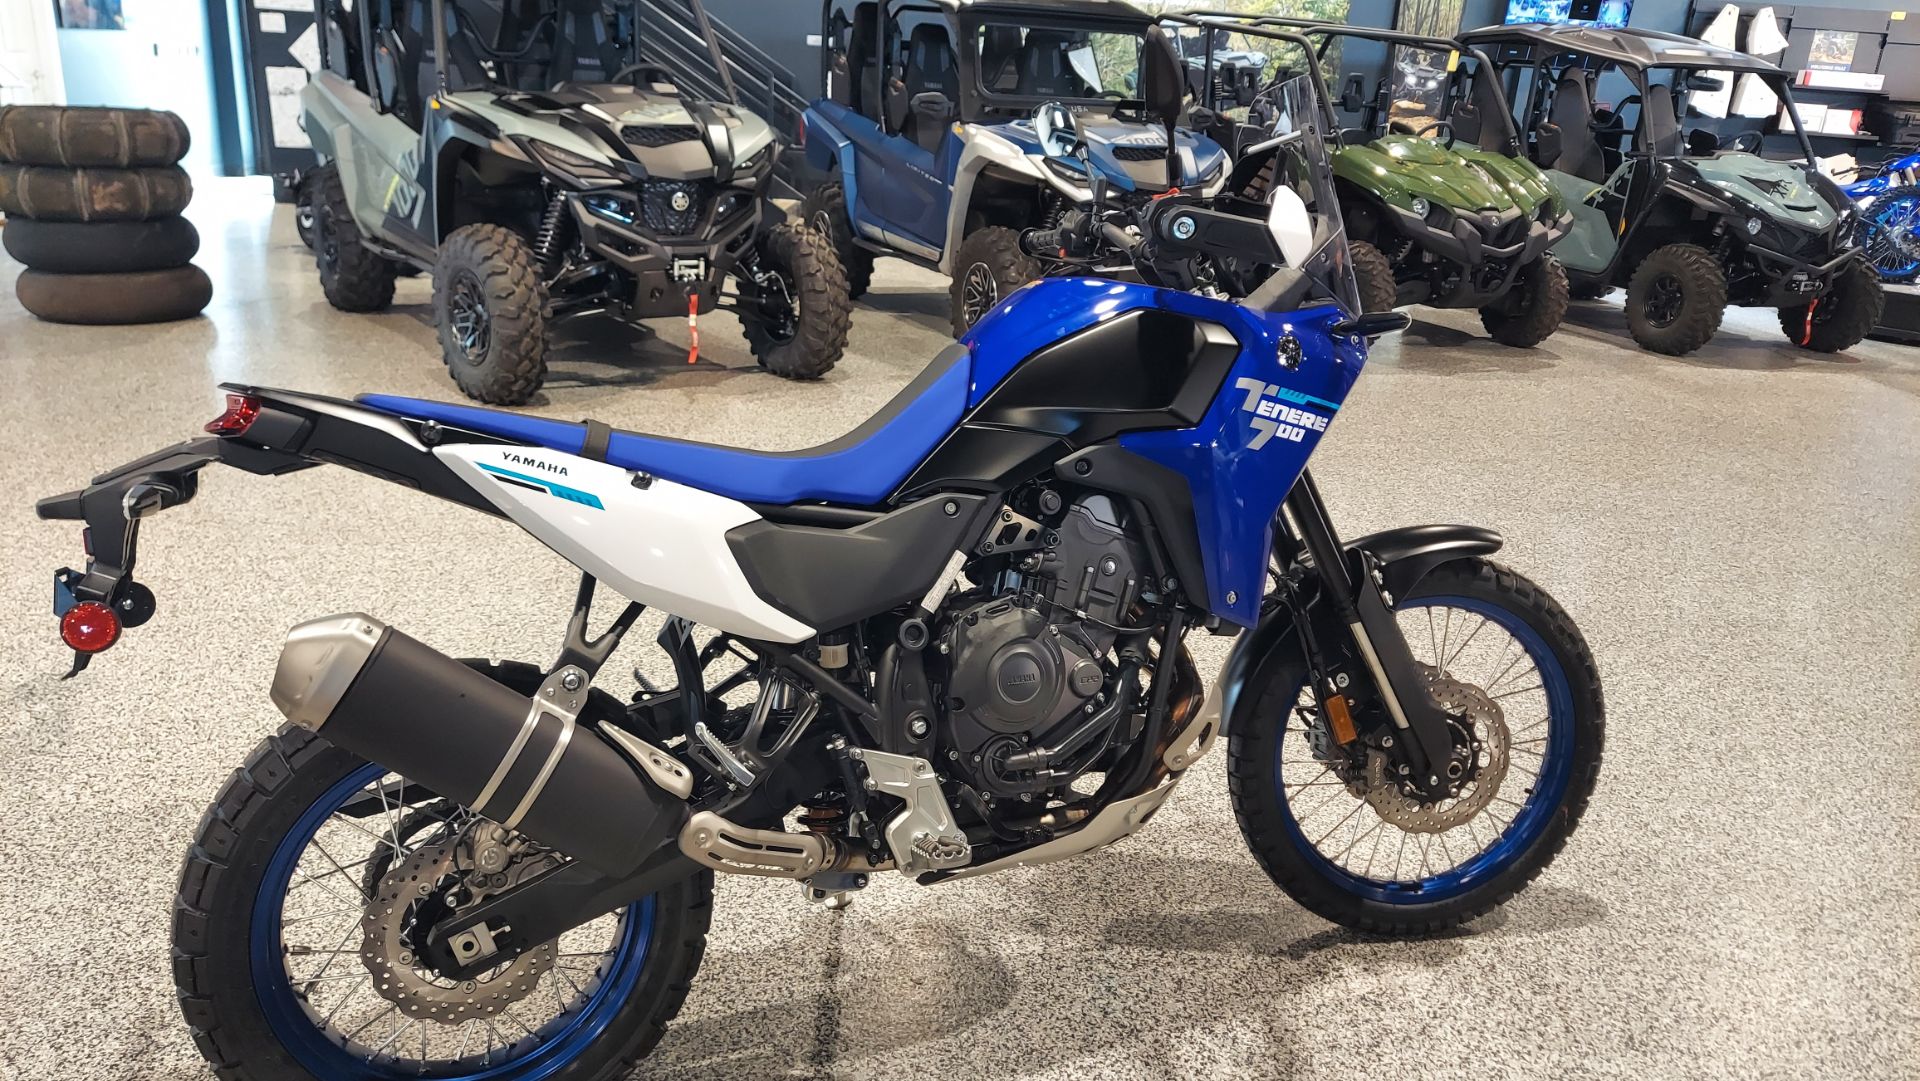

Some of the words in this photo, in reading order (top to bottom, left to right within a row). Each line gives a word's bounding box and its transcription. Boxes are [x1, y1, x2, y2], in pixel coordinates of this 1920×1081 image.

[1070, 105, 1089, 113] USA
[1246, 417, 1306, 451] 700
[502, 451, 568, 476] YAMAHA
